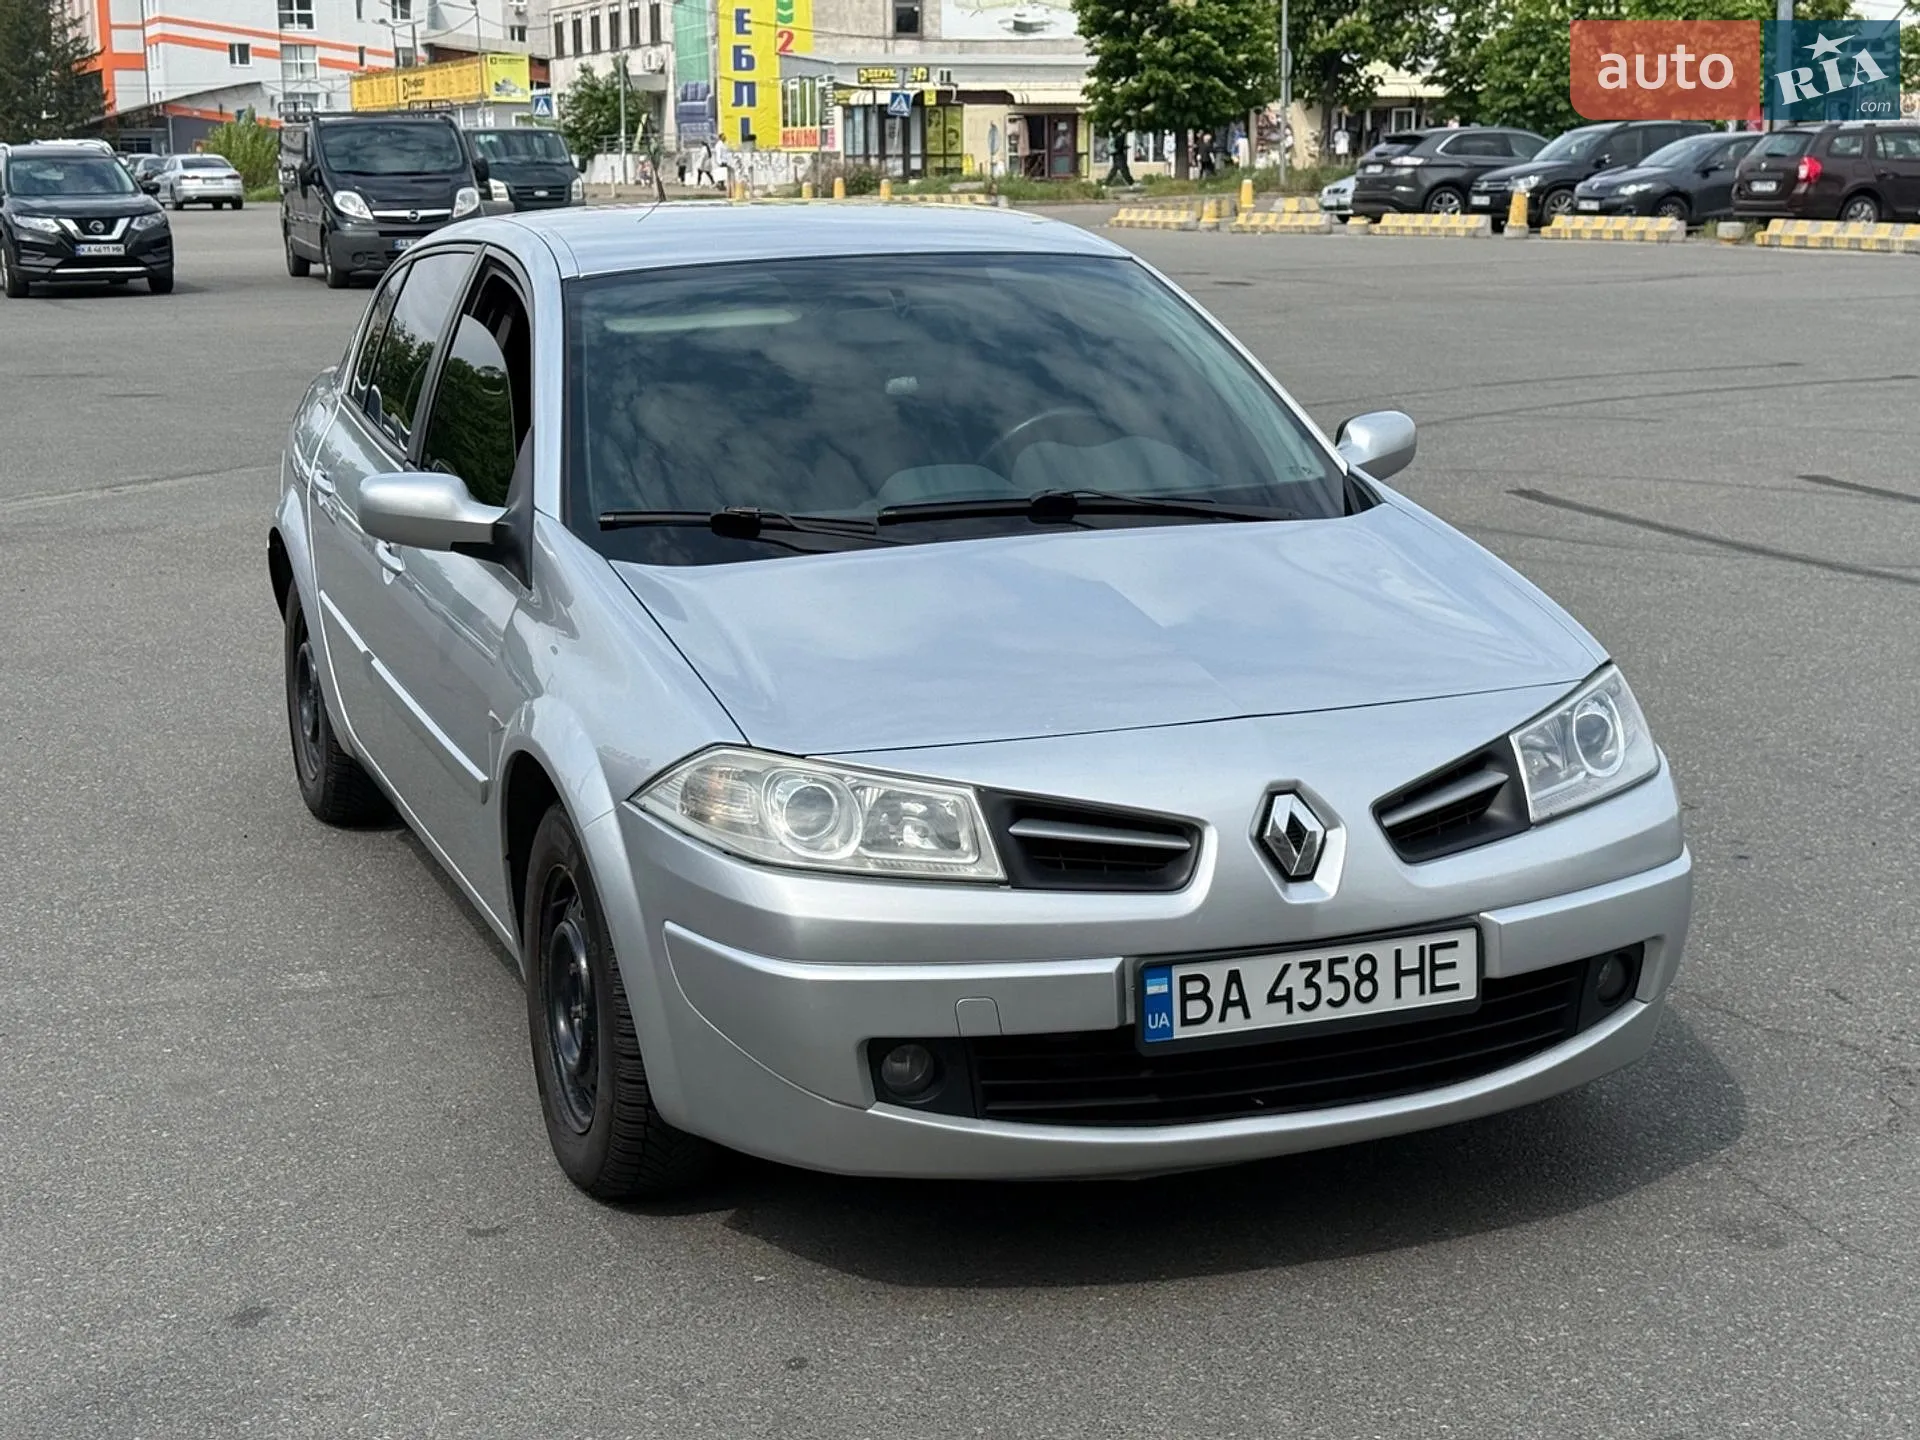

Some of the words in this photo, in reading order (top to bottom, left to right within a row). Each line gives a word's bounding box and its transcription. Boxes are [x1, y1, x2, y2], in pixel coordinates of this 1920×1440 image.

[777, 30, 795, 53] 2
[1178, 969, 1252, 1028] BA
[1265, 953, 1379, 1016] 4358
[1394, 940, 1461, 1000] HE
[1148, 1012, 1170, 1029] UA
